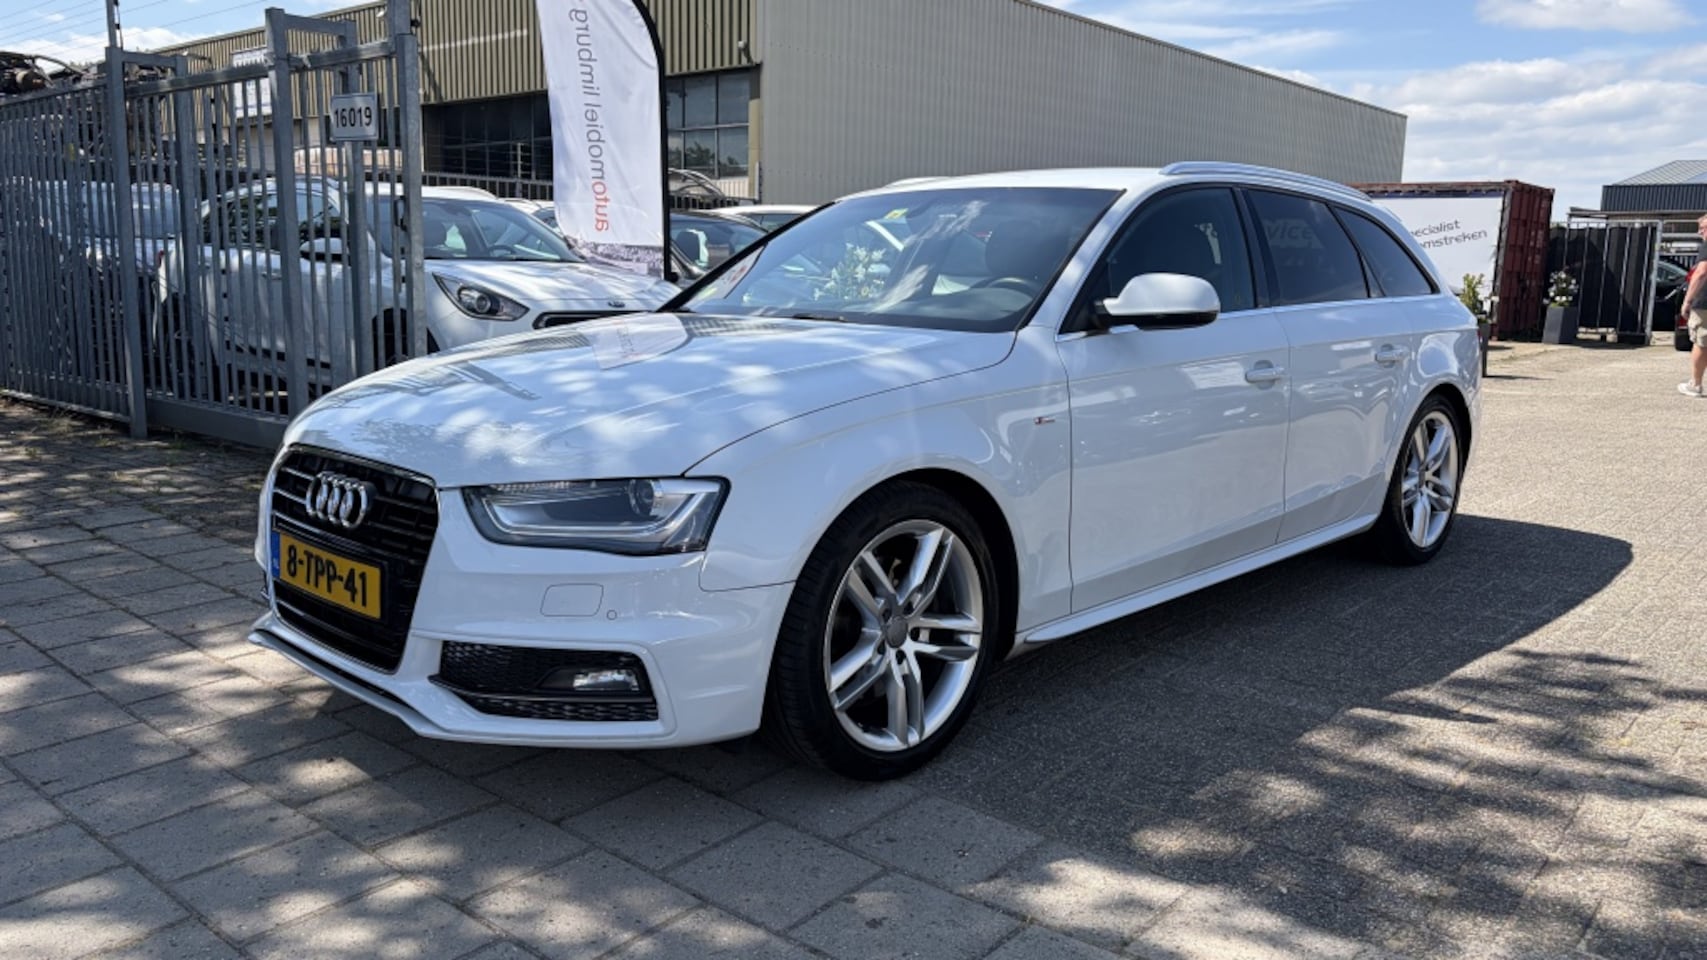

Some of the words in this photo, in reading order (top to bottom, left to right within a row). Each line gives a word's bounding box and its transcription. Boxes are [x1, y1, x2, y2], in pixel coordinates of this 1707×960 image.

[335, 106, 372, 128] 16019
[1411, 220, 1461, 238] ecialist
[287, 544, 367, 608] 8-TPP-41
